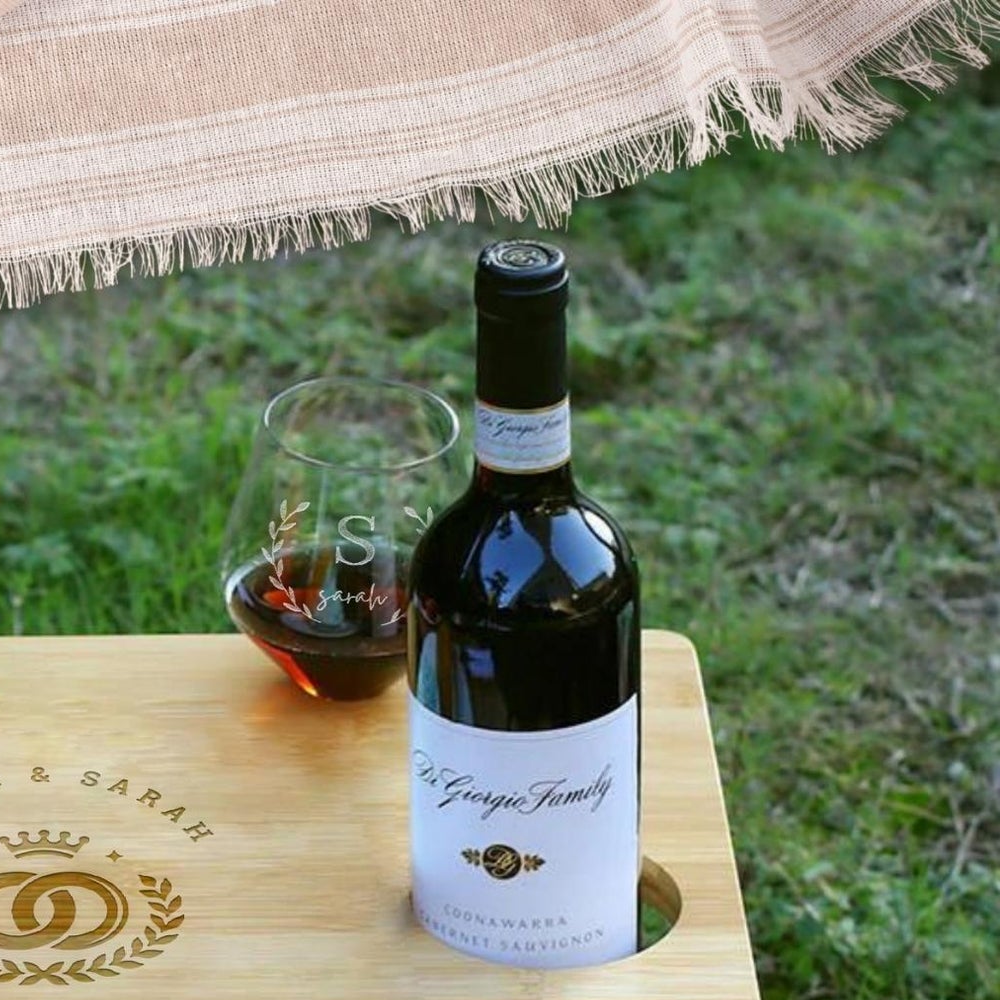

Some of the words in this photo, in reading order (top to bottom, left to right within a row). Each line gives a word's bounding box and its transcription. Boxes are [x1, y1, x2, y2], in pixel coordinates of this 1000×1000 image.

[335, 515, 376, 567] S
[316, 583, 389, 612] sarah
[30, 766, 51, 783] &
[80, 770, 215, 843] SARAH
[413, 750, 438, 788] Di
[438, 768, 527, 821] Giorgio
[517, 762, 614, 815] Family
[443, 903, 568, 930] COONAWARRA
[500, 927, 605, 952] SAUVIGNON
